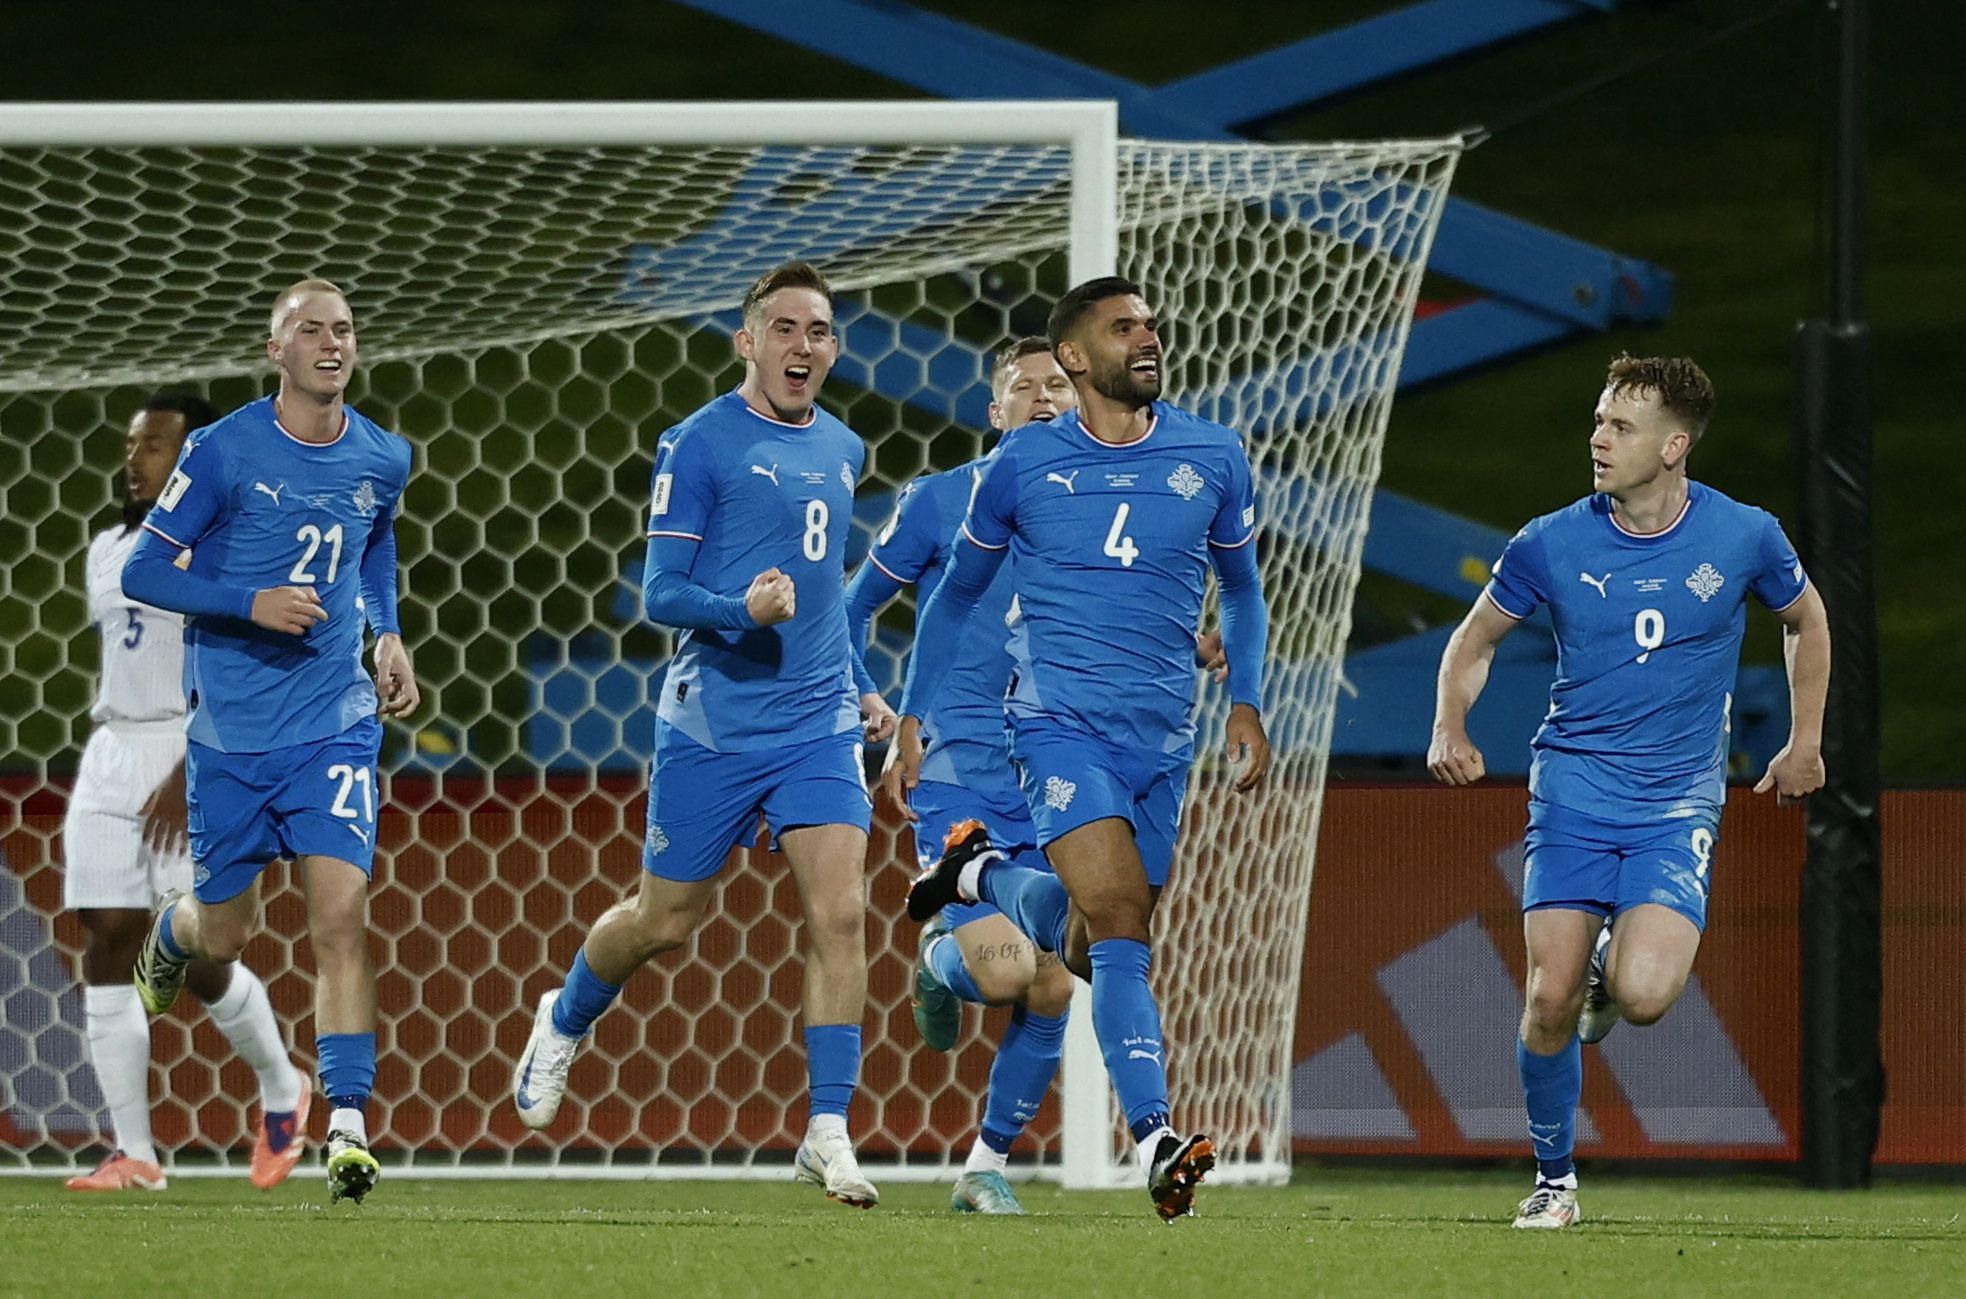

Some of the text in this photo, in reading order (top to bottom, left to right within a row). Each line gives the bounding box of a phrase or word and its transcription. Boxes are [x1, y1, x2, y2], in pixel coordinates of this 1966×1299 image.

[289, 524, 343, 583] 21
[803, 500, 828, 561] 8
[1104, 502, 1139, 567] 4
[123, 607, 143, 648] 5
[1635, 608, 1665, 664] 9
[327, 764, 373, 823] 21
[1691, 827, 1713, 878] 9
